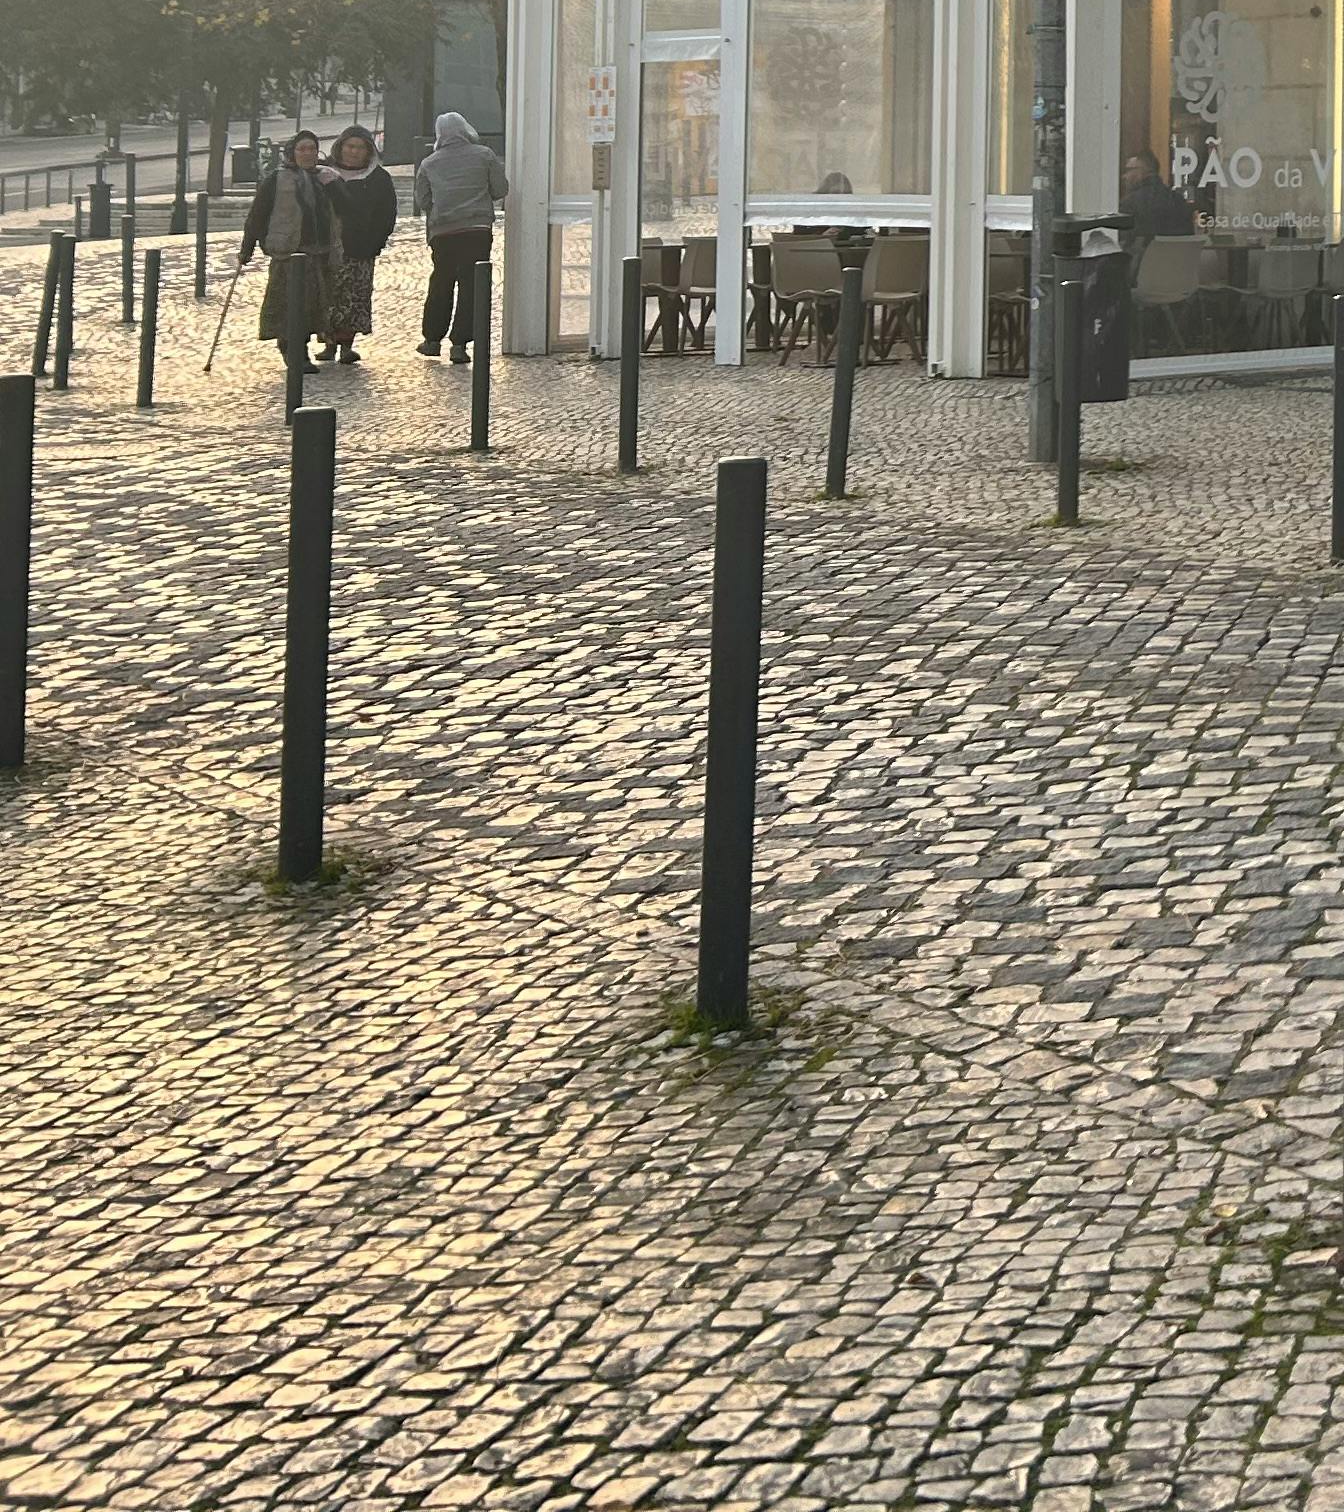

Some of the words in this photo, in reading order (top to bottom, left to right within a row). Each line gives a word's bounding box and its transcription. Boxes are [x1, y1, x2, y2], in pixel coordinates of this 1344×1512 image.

[1173, 136, 1263, 189] PÃO
[1274, 160, 1303, 189] da
[1197, 211, 1229, 228] Casa
[1232, 211, 1250, 228] de
